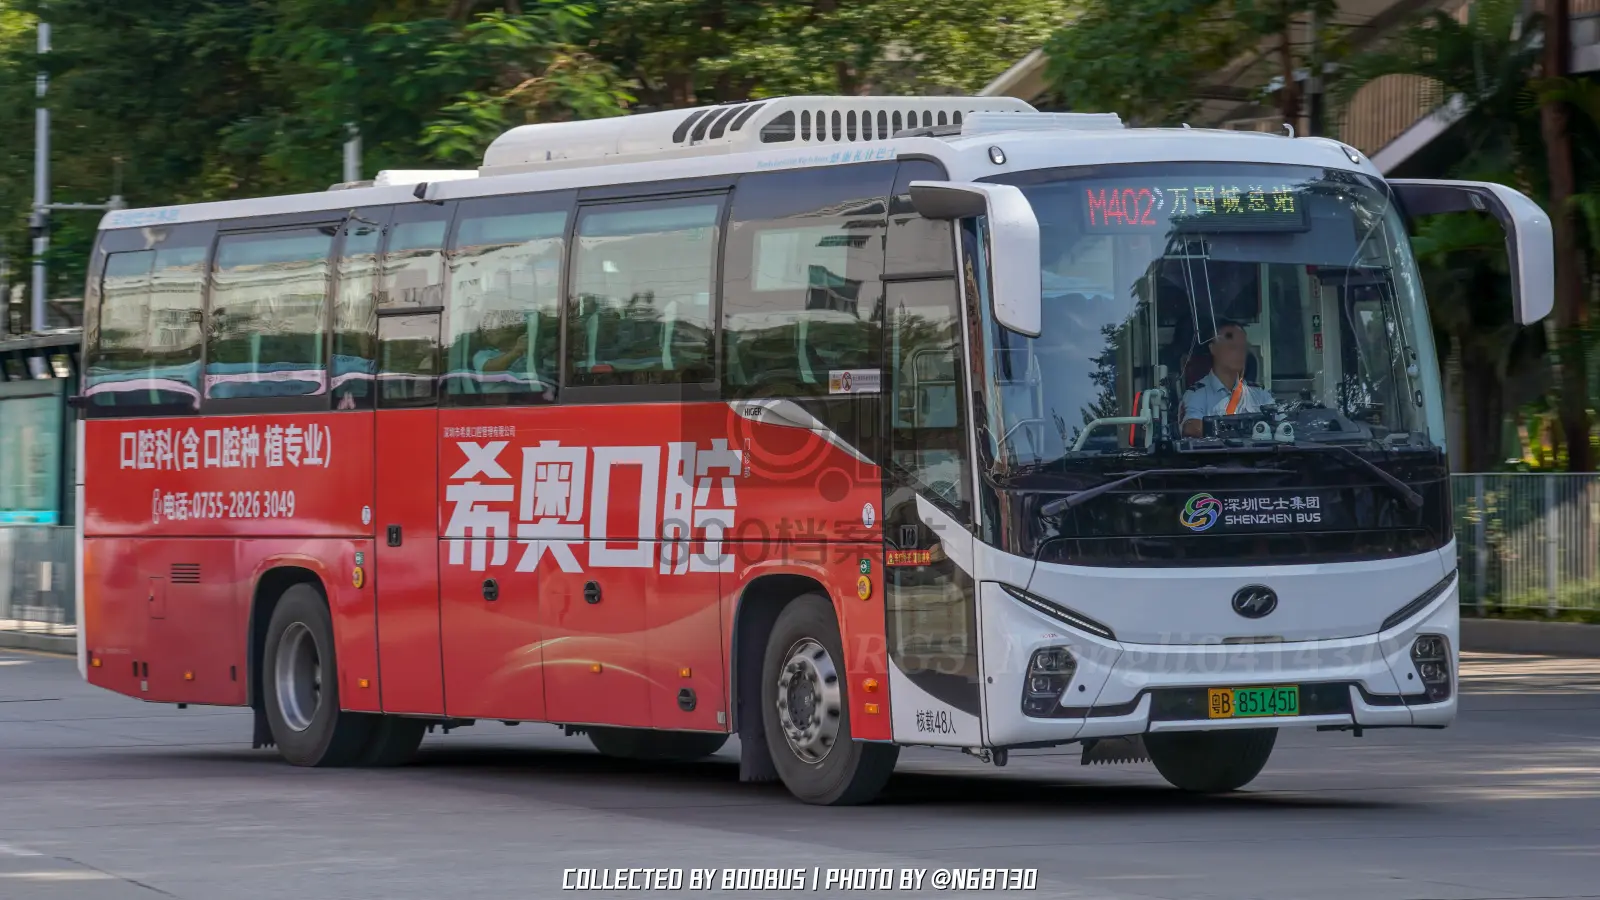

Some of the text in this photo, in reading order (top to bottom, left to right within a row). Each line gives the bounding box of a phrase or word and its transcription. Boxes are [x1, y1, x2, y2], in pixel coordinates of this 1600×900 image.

[1086, 187, 1157, 226] M402
[1166, 185, 1295, 216] 万国城总站
[744, 407, 762, 417] HIGER
[445, 438, 742, 575] 希奥口腔
[1224, 496, 1320, 512] 深圳巴士集团
[1224, 513, 1321, 525] SHENZHEN BUS
[916, 708, 956, 734] 核载48人
